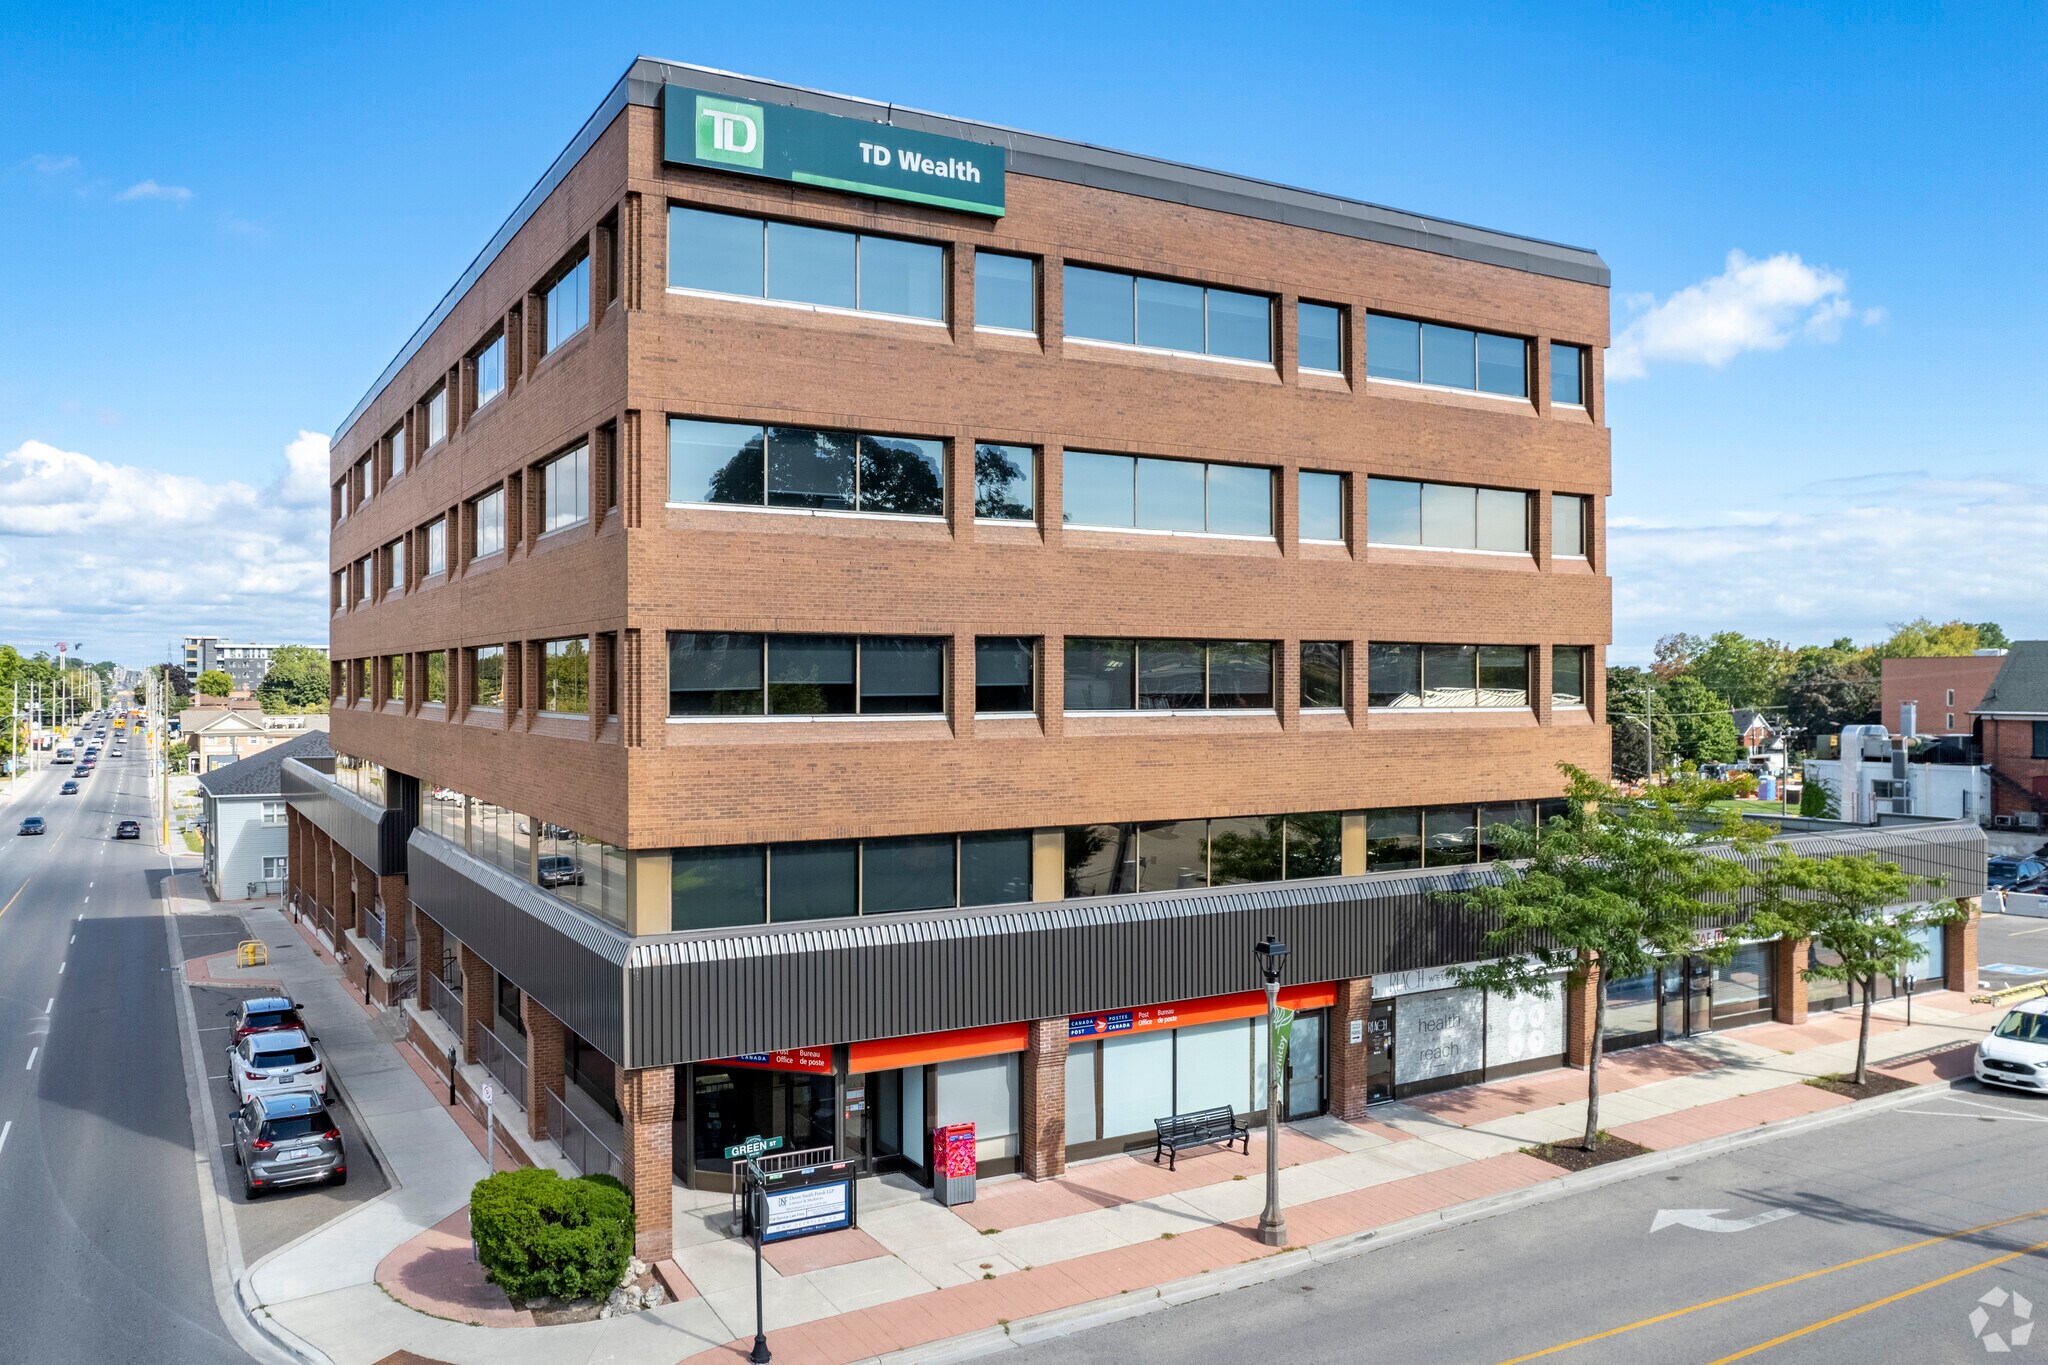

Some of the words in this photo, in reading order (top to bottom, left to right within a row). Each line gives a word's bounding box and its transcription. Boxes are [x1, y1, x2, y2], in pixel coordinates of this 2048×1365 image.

[700, 108, 757, 154] TD
[859, 142, 891, 167] TD
[898, 149, 981, 184] Wealth
[1389, 969, 1425, 994] REACH
[1138, 1011, 1149, 1019] Post
[1157, 1008, 1174, 1016] Bureau
[1070, 1019, 1094, 1027] CANADA
[1164, 1015, 1178, 1024] poste
[1418, 1013, 1461, 1033] health
[1108, 1022, 1130, 1030] CANADA
[1368, 1019, 1388, 1034] REACH
[799, 1049, 821, 1058] Bureau
[1420, 1041, 1459, 1061] reach
[776, 1055, 794, 1064] Office
[799, 1057, 808, 1065] de
[808, 1058, 825, 1067] poste
[731, 1141, 767, 1156] GREEN
